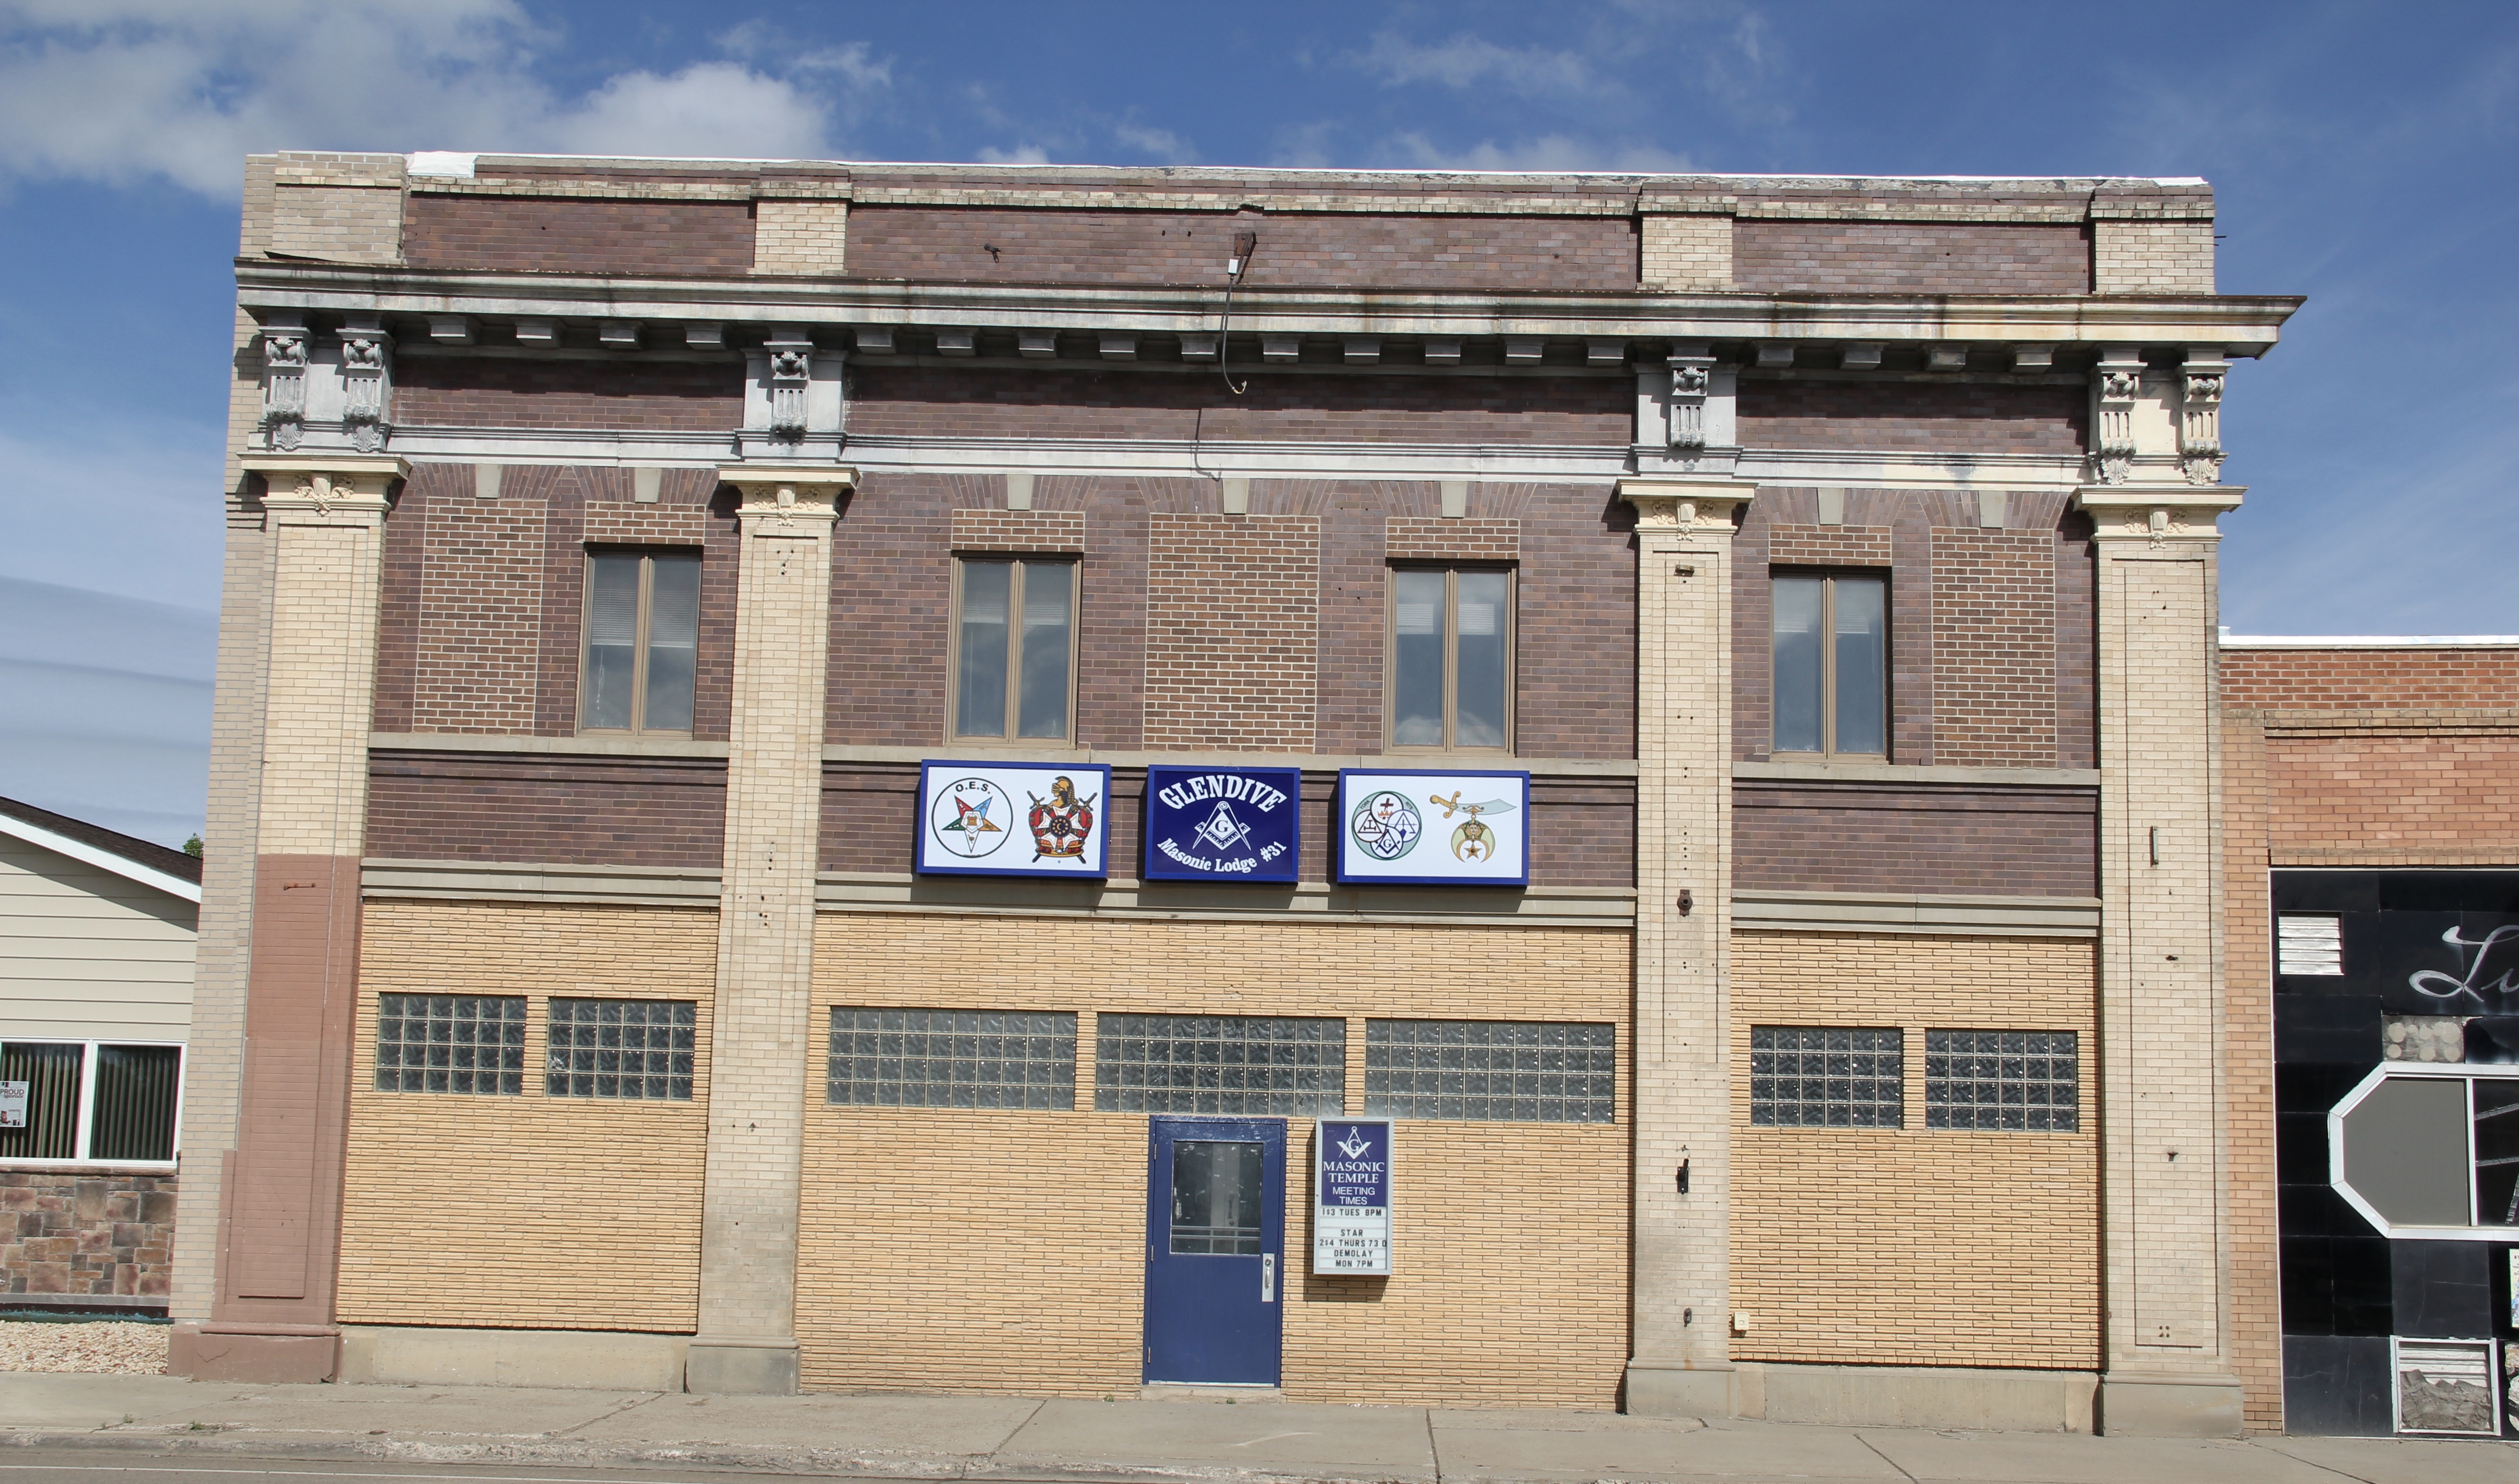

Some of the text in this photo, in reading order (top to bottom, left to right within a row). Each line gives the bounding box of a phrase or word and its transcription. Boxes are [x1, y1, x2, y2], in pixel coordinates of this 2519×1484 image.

[955, 781, 991, 795] O.E.S.
[1159, 775, 1287, 813] GLENDIVE
[1360, 799, 1414, 810] YORK RITE
[1215, 820, 1229, 833] G
[1383, 839, 1392, 848] G
[1157, 838, 1287, 873] Masonic Lodge #31
[1348, 1138, 1360, 1152] G
[1323, 1161, 1385, 1172] MASONIC
[1329, 1173, 1379, 1184] TEMPLE
[1332, 1186, 1375, 1196] MEETING
[1339, 1196, 1368, 1205] TIMES
